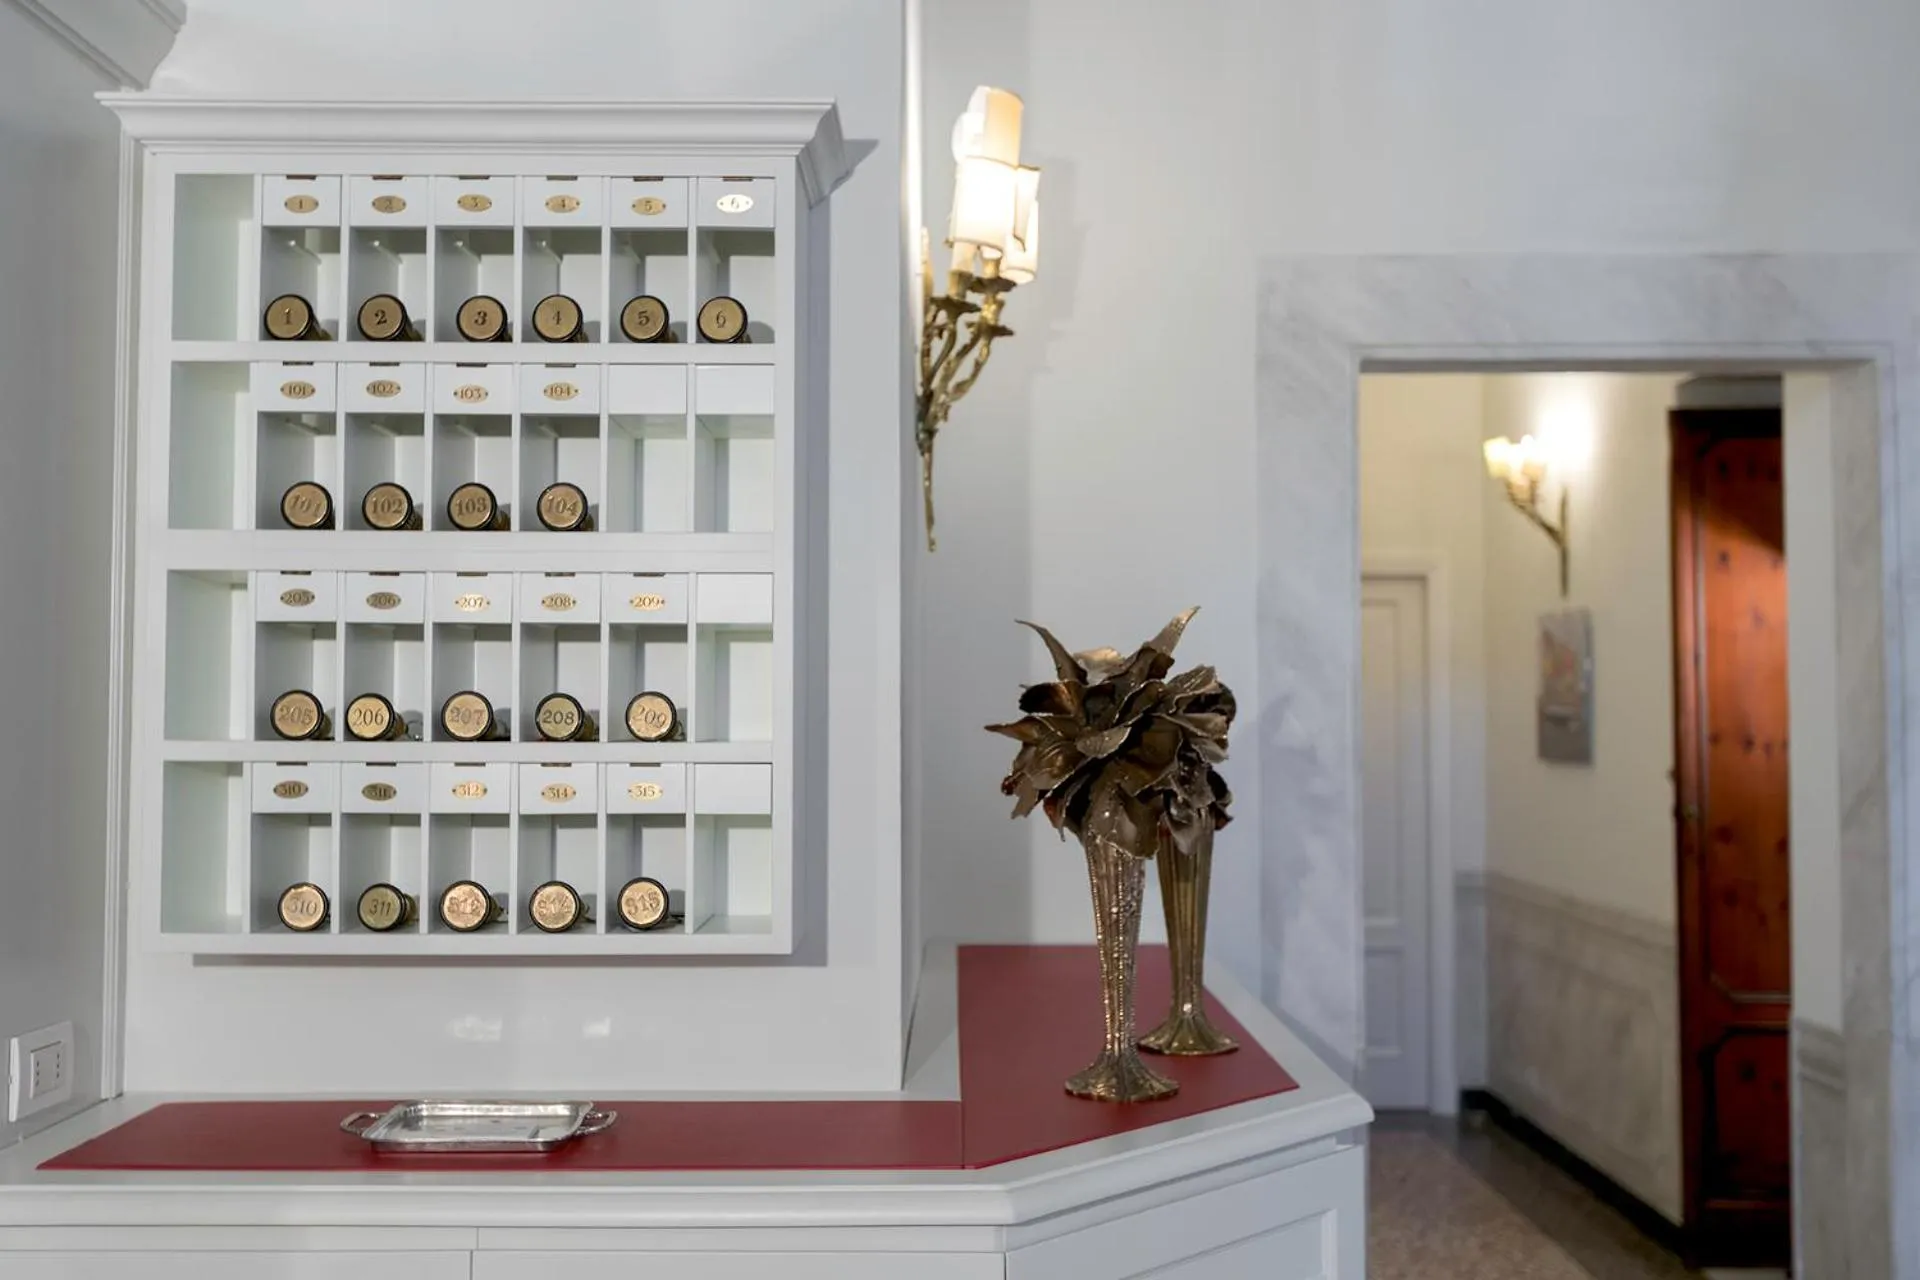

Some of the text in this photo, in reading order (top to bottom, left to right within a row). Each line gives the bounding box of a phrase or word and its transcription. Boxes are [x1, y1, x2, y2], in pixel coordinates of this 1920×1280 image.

[374, 309, 388, 326] 2
[474, 310, 488, 326] 3
[552, 310, 562, 326] 4
[637, 310, 650, 327] 5
[715, 310, 727, 328] 6
[288, 384, 307, 396] 101
[371, 383, 394, 395] 102
[460, 388, 481, 400] 103
[550, 385, 571, 397] 104
[370, 497, 402, 515] 102
[456, 497, 488, 516] 103
[546, 494, 577, 516] 104
[461, 596, 484, 608] 207
[545, 596, 572, 608] 208
[634, 596, 660, 608] 209
[279, 705, 314, 724] 205
[352, 708, 384, 726] 206
[449, 706, 485, 726] 207
[542, 709, 575, 725] 208
[632, 704, 667, 729] 209
[459, 784, 480, 796] 312
[548, 787, 569, 799] 314
[635, 785, 655, 797] 315
[288, 898, 318, 917] 310
[369, 900, 391, 915] 311
